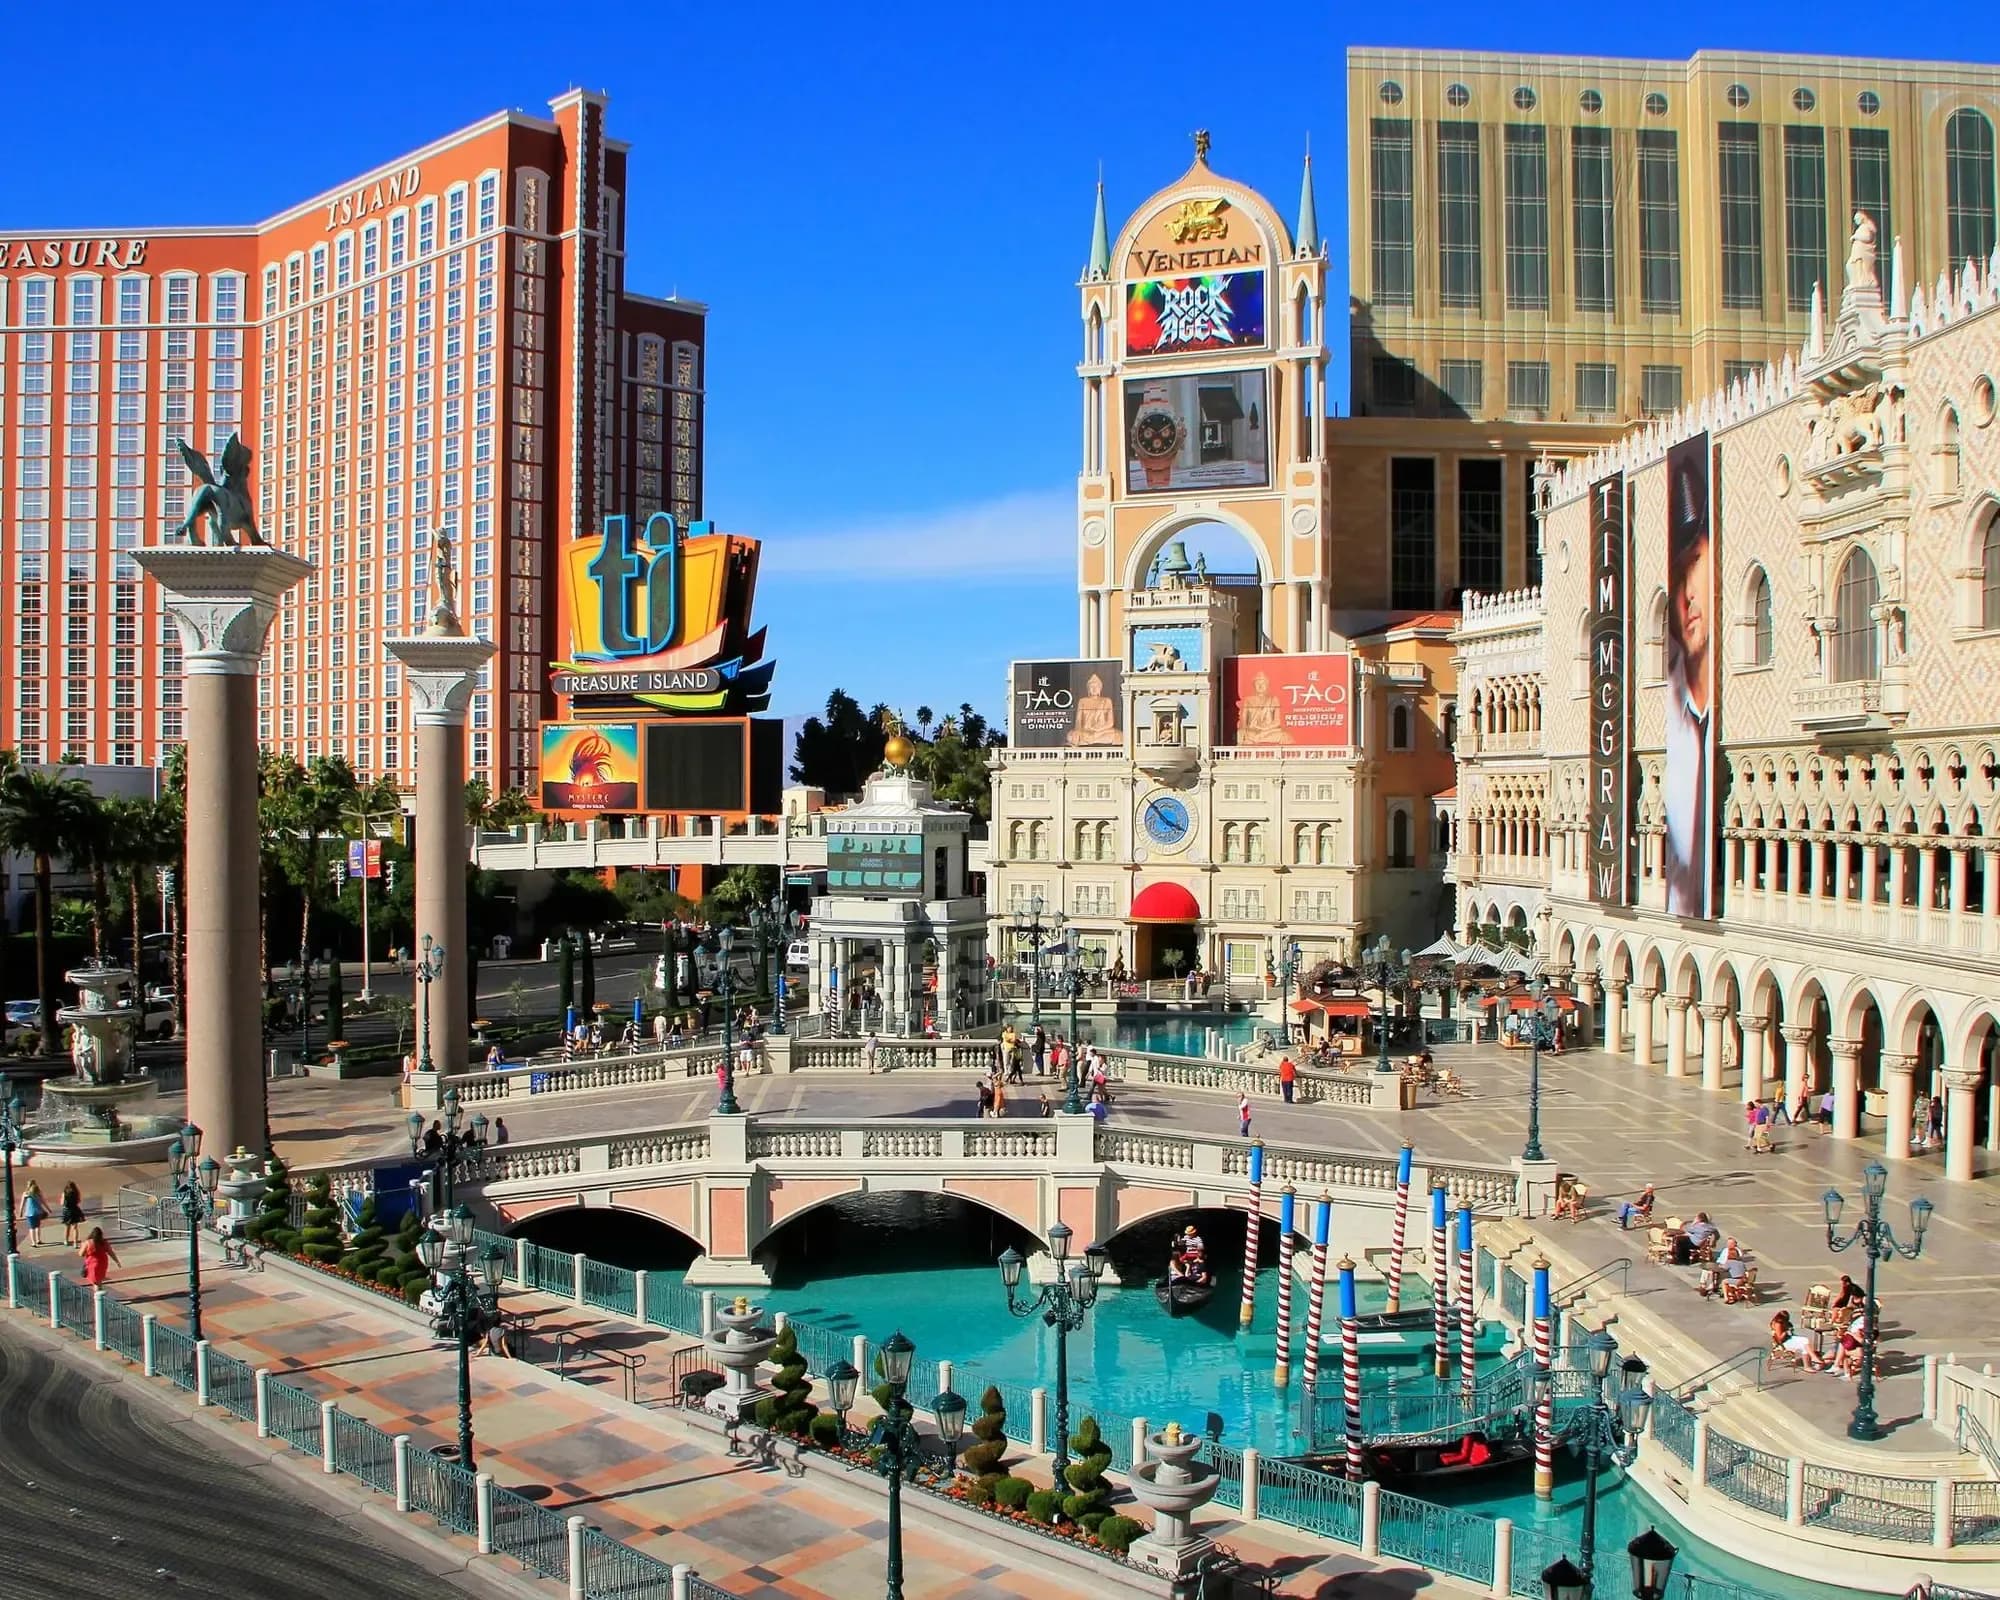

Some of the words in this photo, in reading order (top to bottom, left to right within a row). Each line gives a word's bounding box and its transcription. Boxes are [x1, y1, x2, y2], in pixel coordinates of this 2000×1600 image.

[325, 166, 421, 232] ISLAND
[1131, 245, 1261, 276] VENETIAN
[1156, 276, 1235, 323] ROCK
[1155, 310, 1235, 350] AGES
[1599, 481, 1613, 613] TIM
[587, 511, 677, 656] ti
[562, 674, 639, 692] TREASURE
[649, 672, 708, 690] ISLAND
[1016, 689, 1073, 710] TAO
[1281, 683, 1346, 705] TAO
